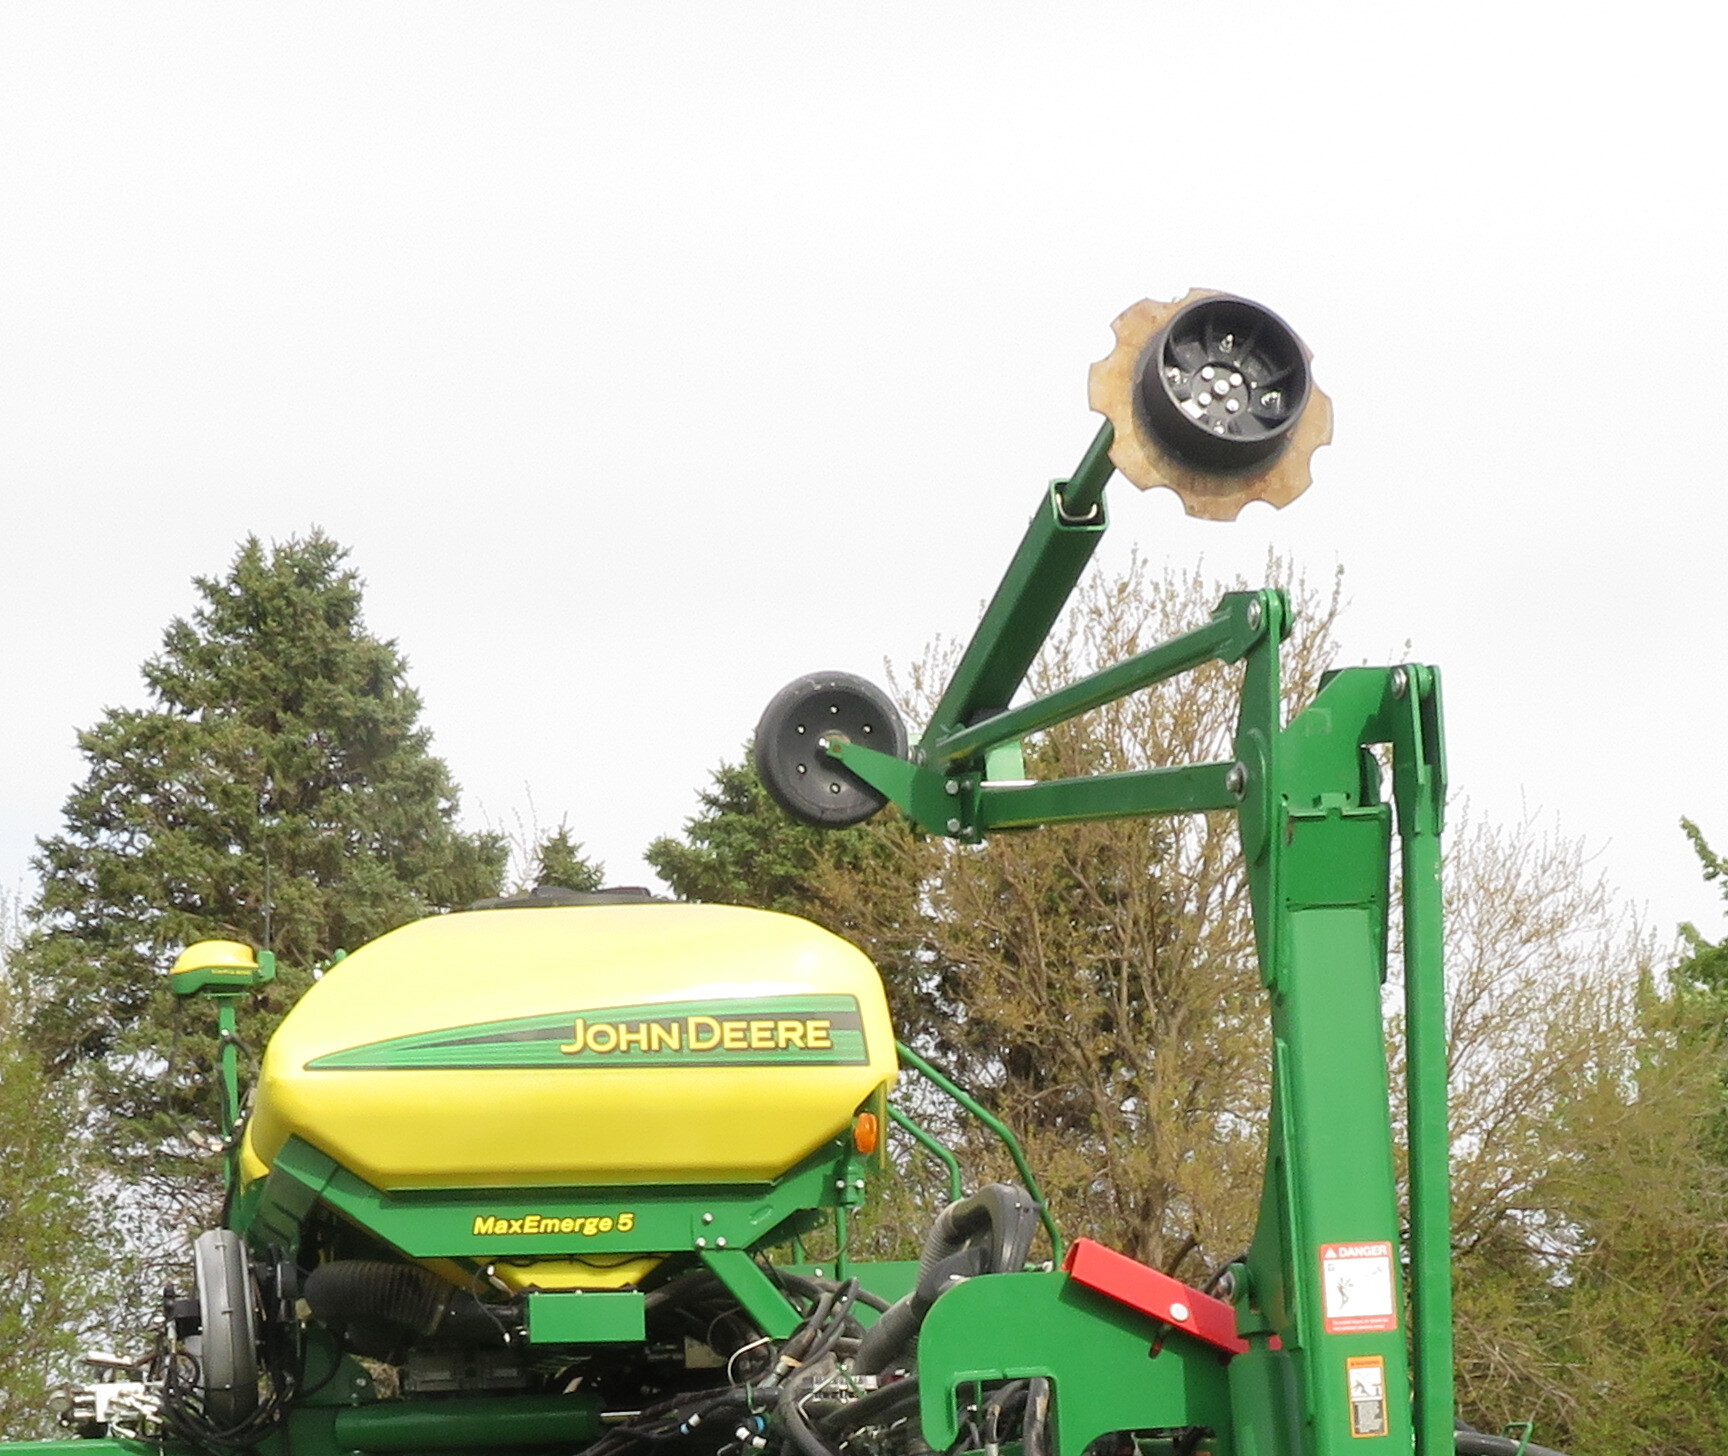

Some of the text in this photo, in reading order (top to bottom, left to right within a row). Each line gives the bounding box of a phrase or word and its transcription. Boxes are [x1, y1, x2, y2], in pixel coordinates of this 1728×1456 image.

[560, 1016, 832, 1054] JOHN DEERE
[473, 1213, 634, 1236] MaxEmerge 5
[1338, 1245, 1388, 1257] DANGER
